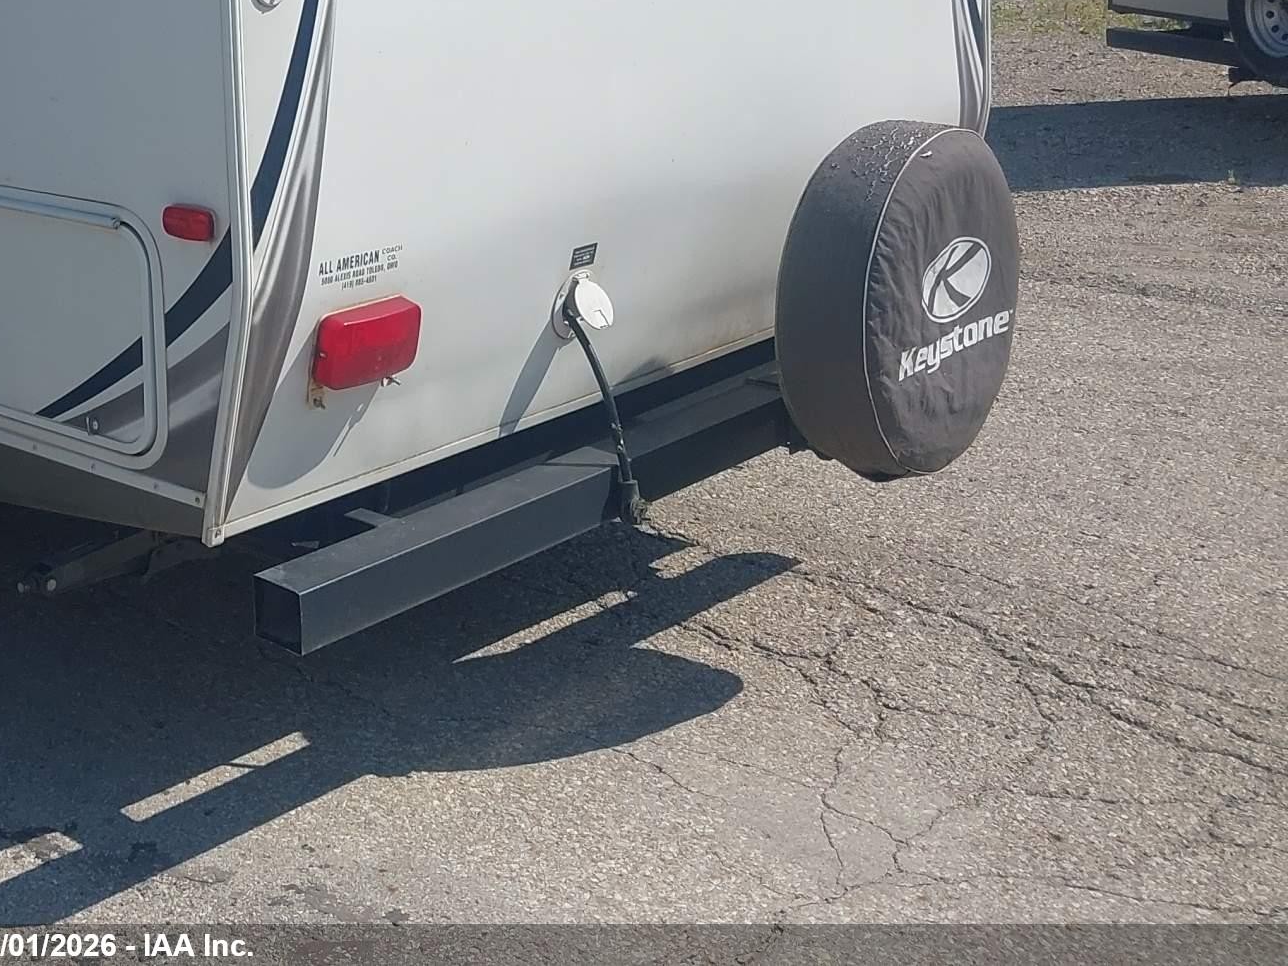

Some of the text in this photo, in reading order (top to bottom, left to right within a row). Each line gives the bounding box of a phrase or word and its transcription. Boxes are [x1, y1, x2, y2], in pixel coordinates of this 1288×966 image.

[318, 260, 333, 276] ALL
[336, 250, 380, 272] AMERICAN
[899, 310, 1011, 381] Keystone
